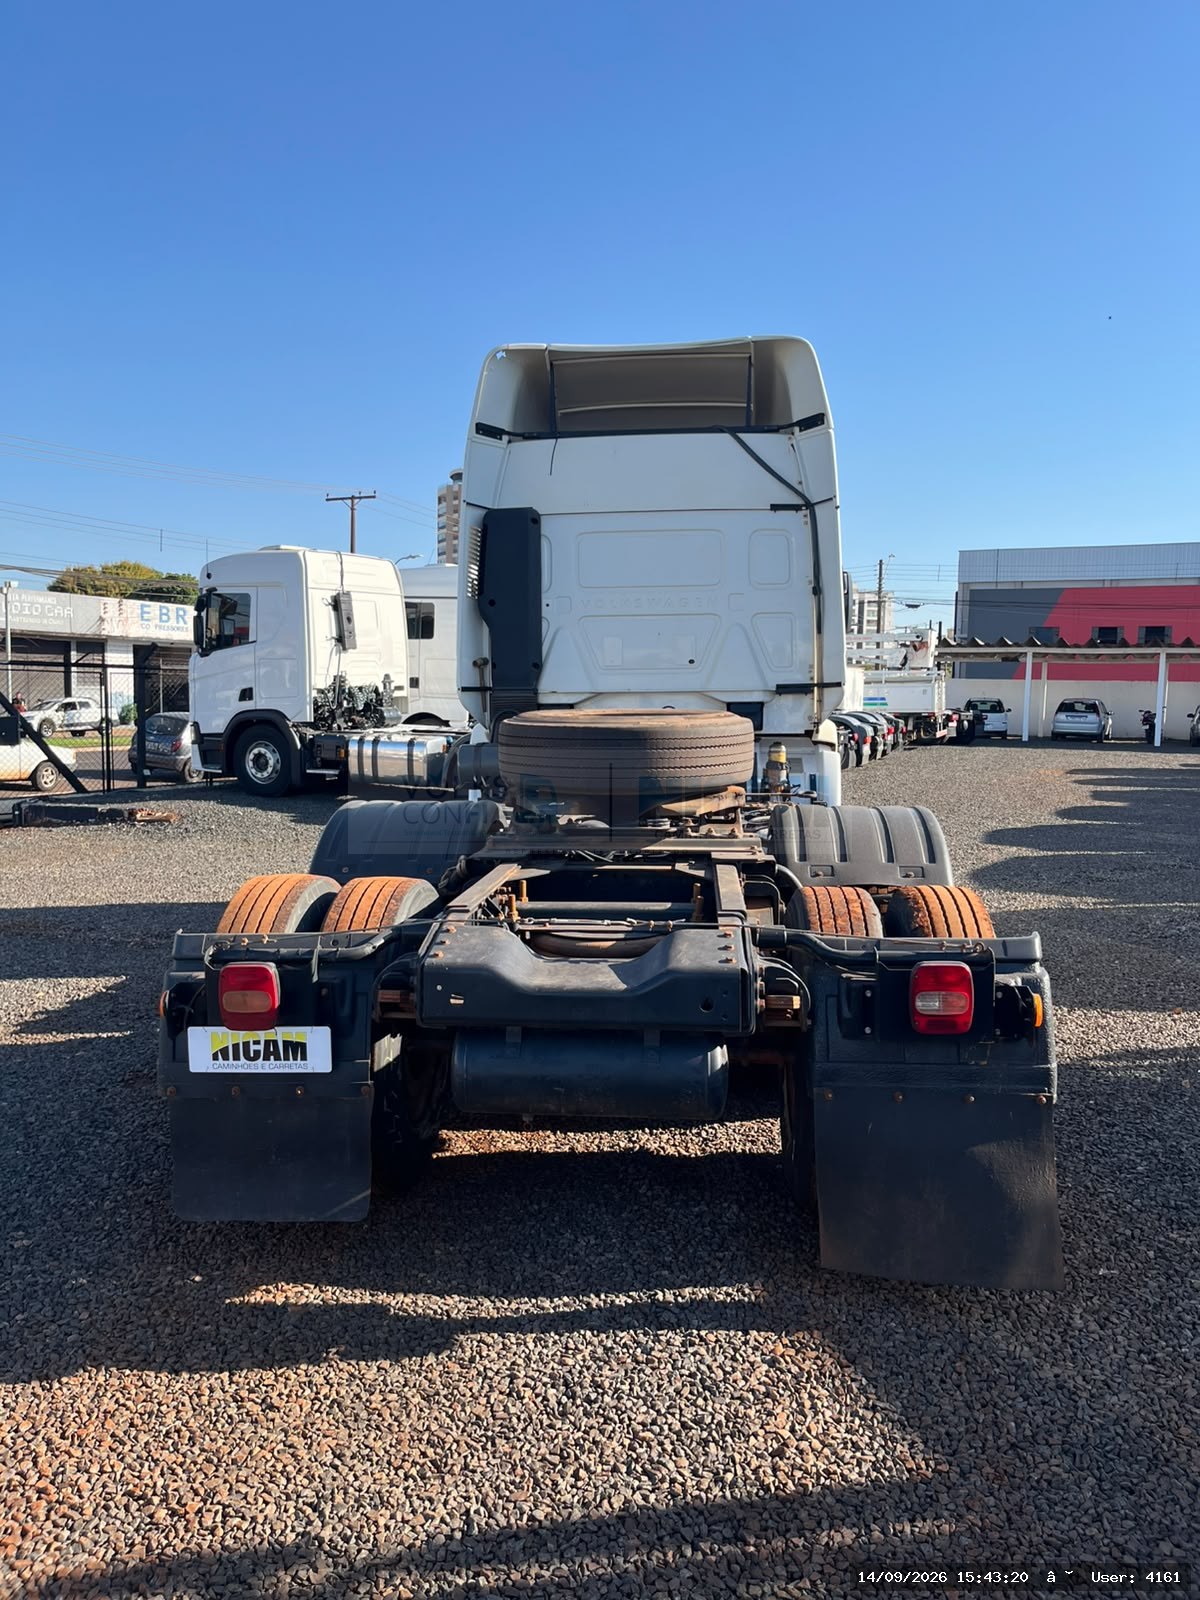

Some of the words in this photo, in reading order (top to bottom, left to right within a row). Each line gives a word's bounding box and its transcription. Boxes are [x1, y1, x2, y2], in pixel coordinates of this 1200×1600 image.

[579, 595, 718, 609] VOLKSWAGEN
[140, 603, 189, 625] EBR
[211, 1031, 308, 1062] NICAM
[212, 1062, 259, 1070] CAMINHÕES
